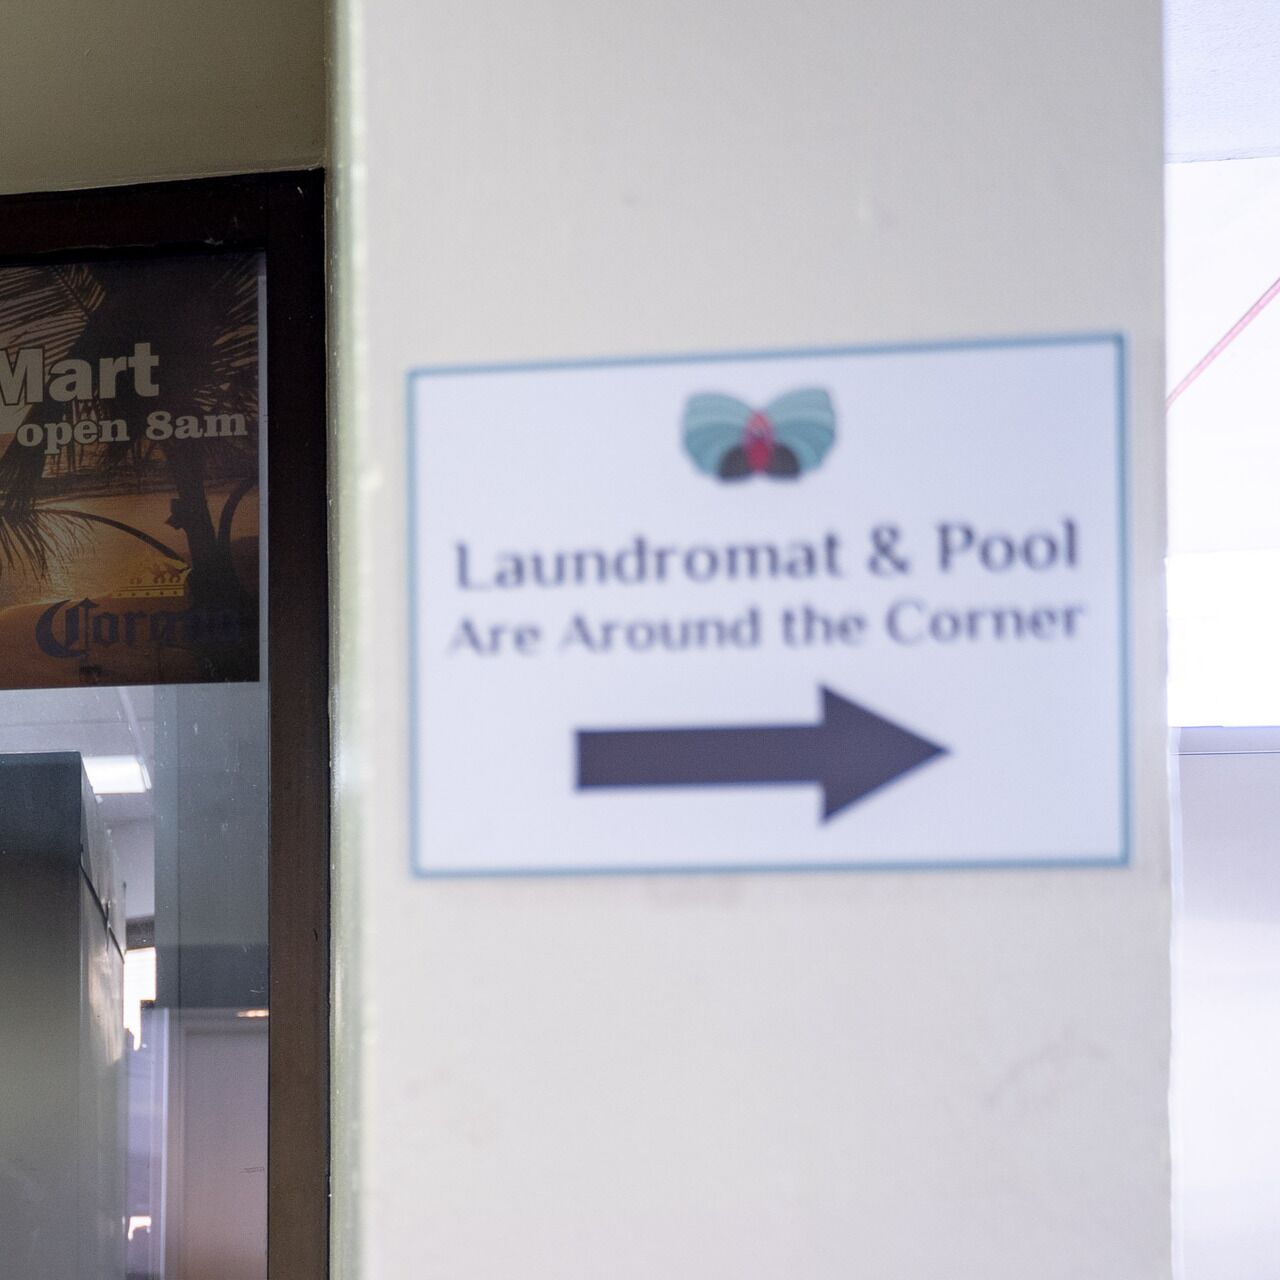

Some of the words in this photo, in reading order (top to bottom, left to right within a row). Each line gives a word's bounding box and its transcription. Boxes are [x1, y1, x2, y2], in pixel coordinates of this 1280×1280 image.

[17, 416, 130, 455] open
[145, 410, 249, 441] 8am
[452, 526, 844, 594] Laundromat
[865, 521, 911, 577] &
[936, 518, 1079, 577] Pool
[446, 613, 543, 659] Are
[559, 602, 762, 653] Around
[781, 602, 867, 649] the
[886, 597, 1085, 645] Corner
